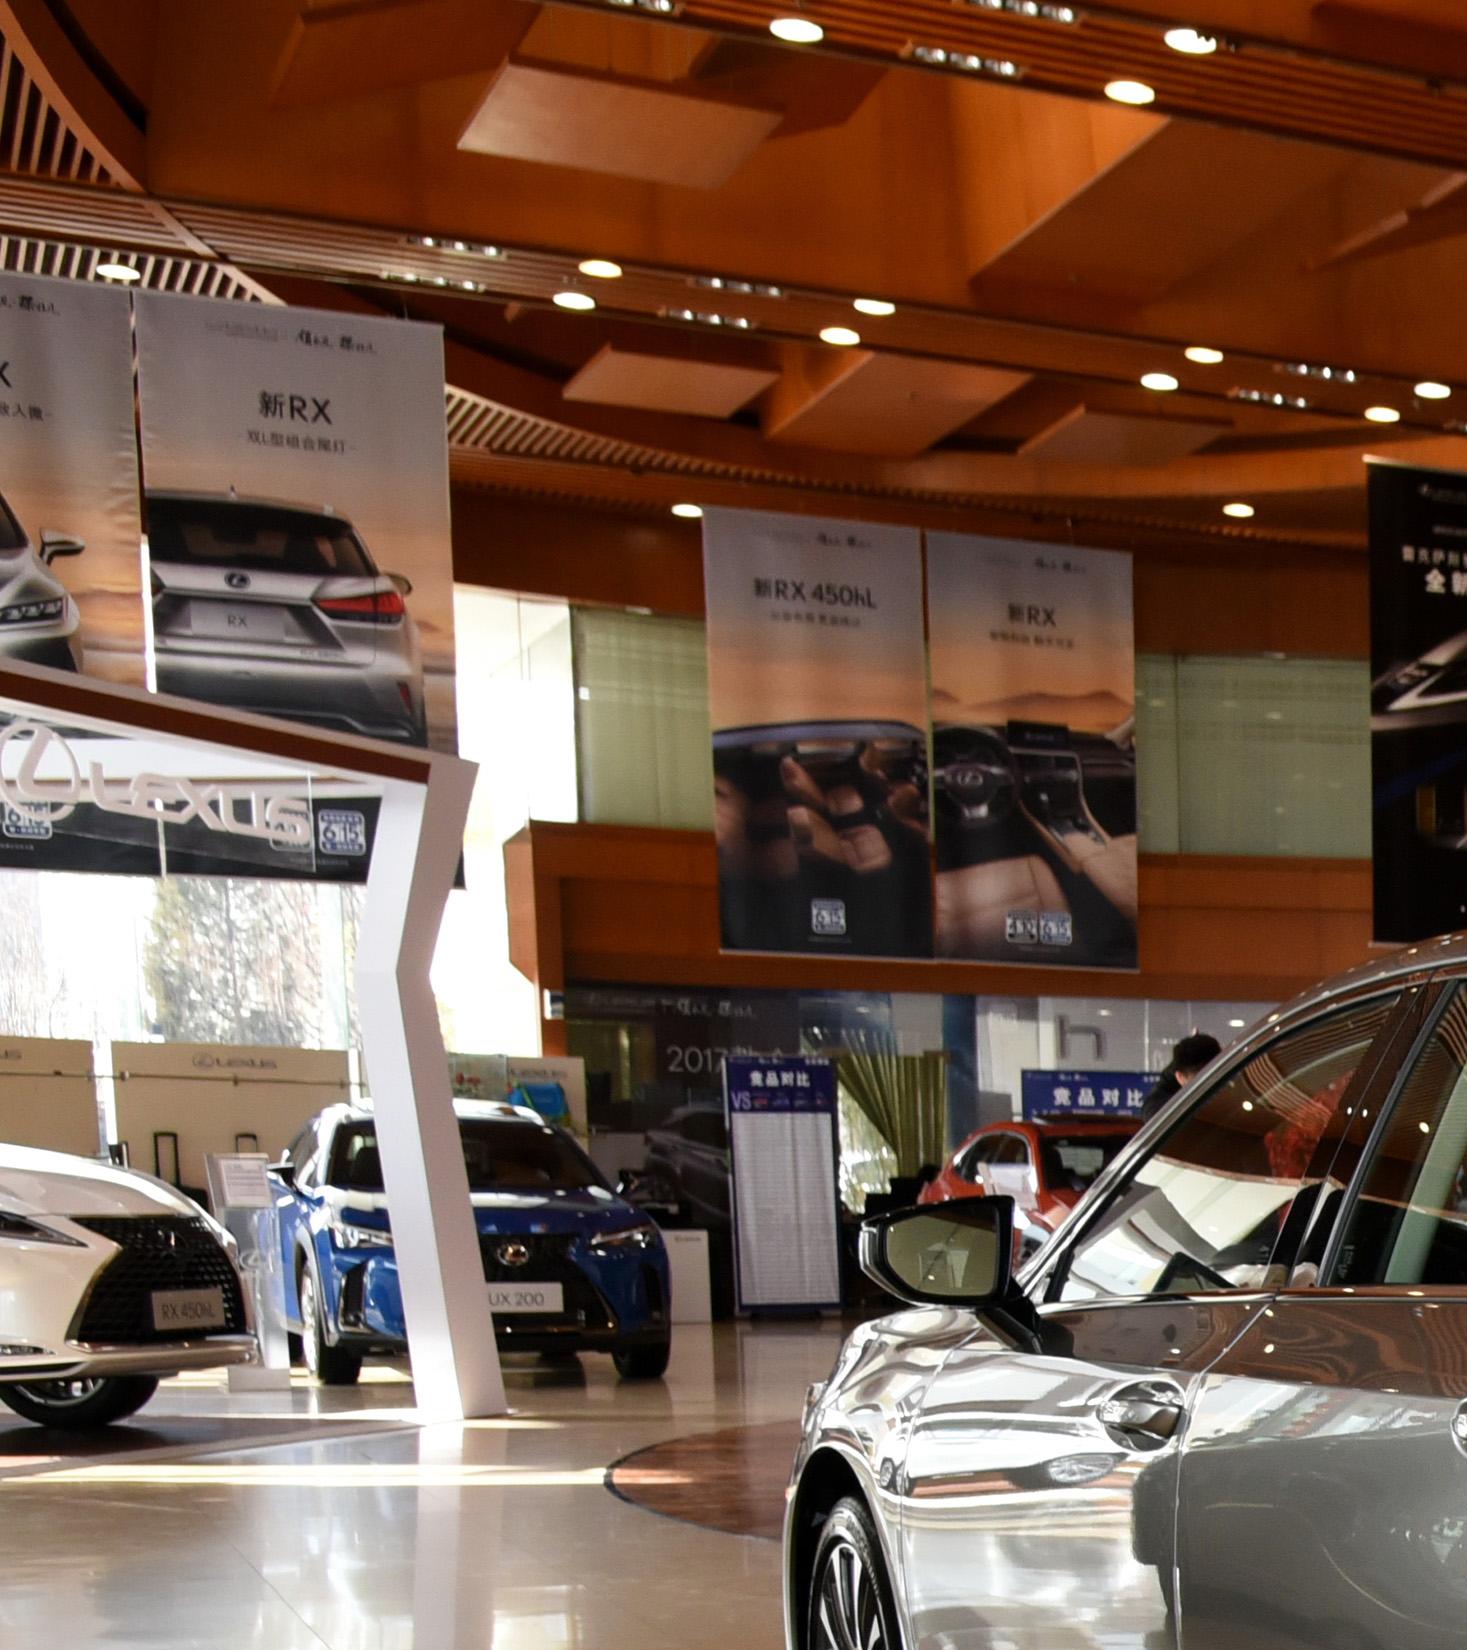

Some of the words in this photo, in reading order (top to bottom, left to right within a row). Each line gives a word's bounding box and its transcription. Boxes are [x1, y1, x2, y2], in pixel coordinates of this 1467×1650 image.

[259, 390, 332, 425] 新RX
[89, 761, 312, 846] LEXUS
[487, 1291, 511, 1307] UX
[514, 1291, 545, 1307] 200
